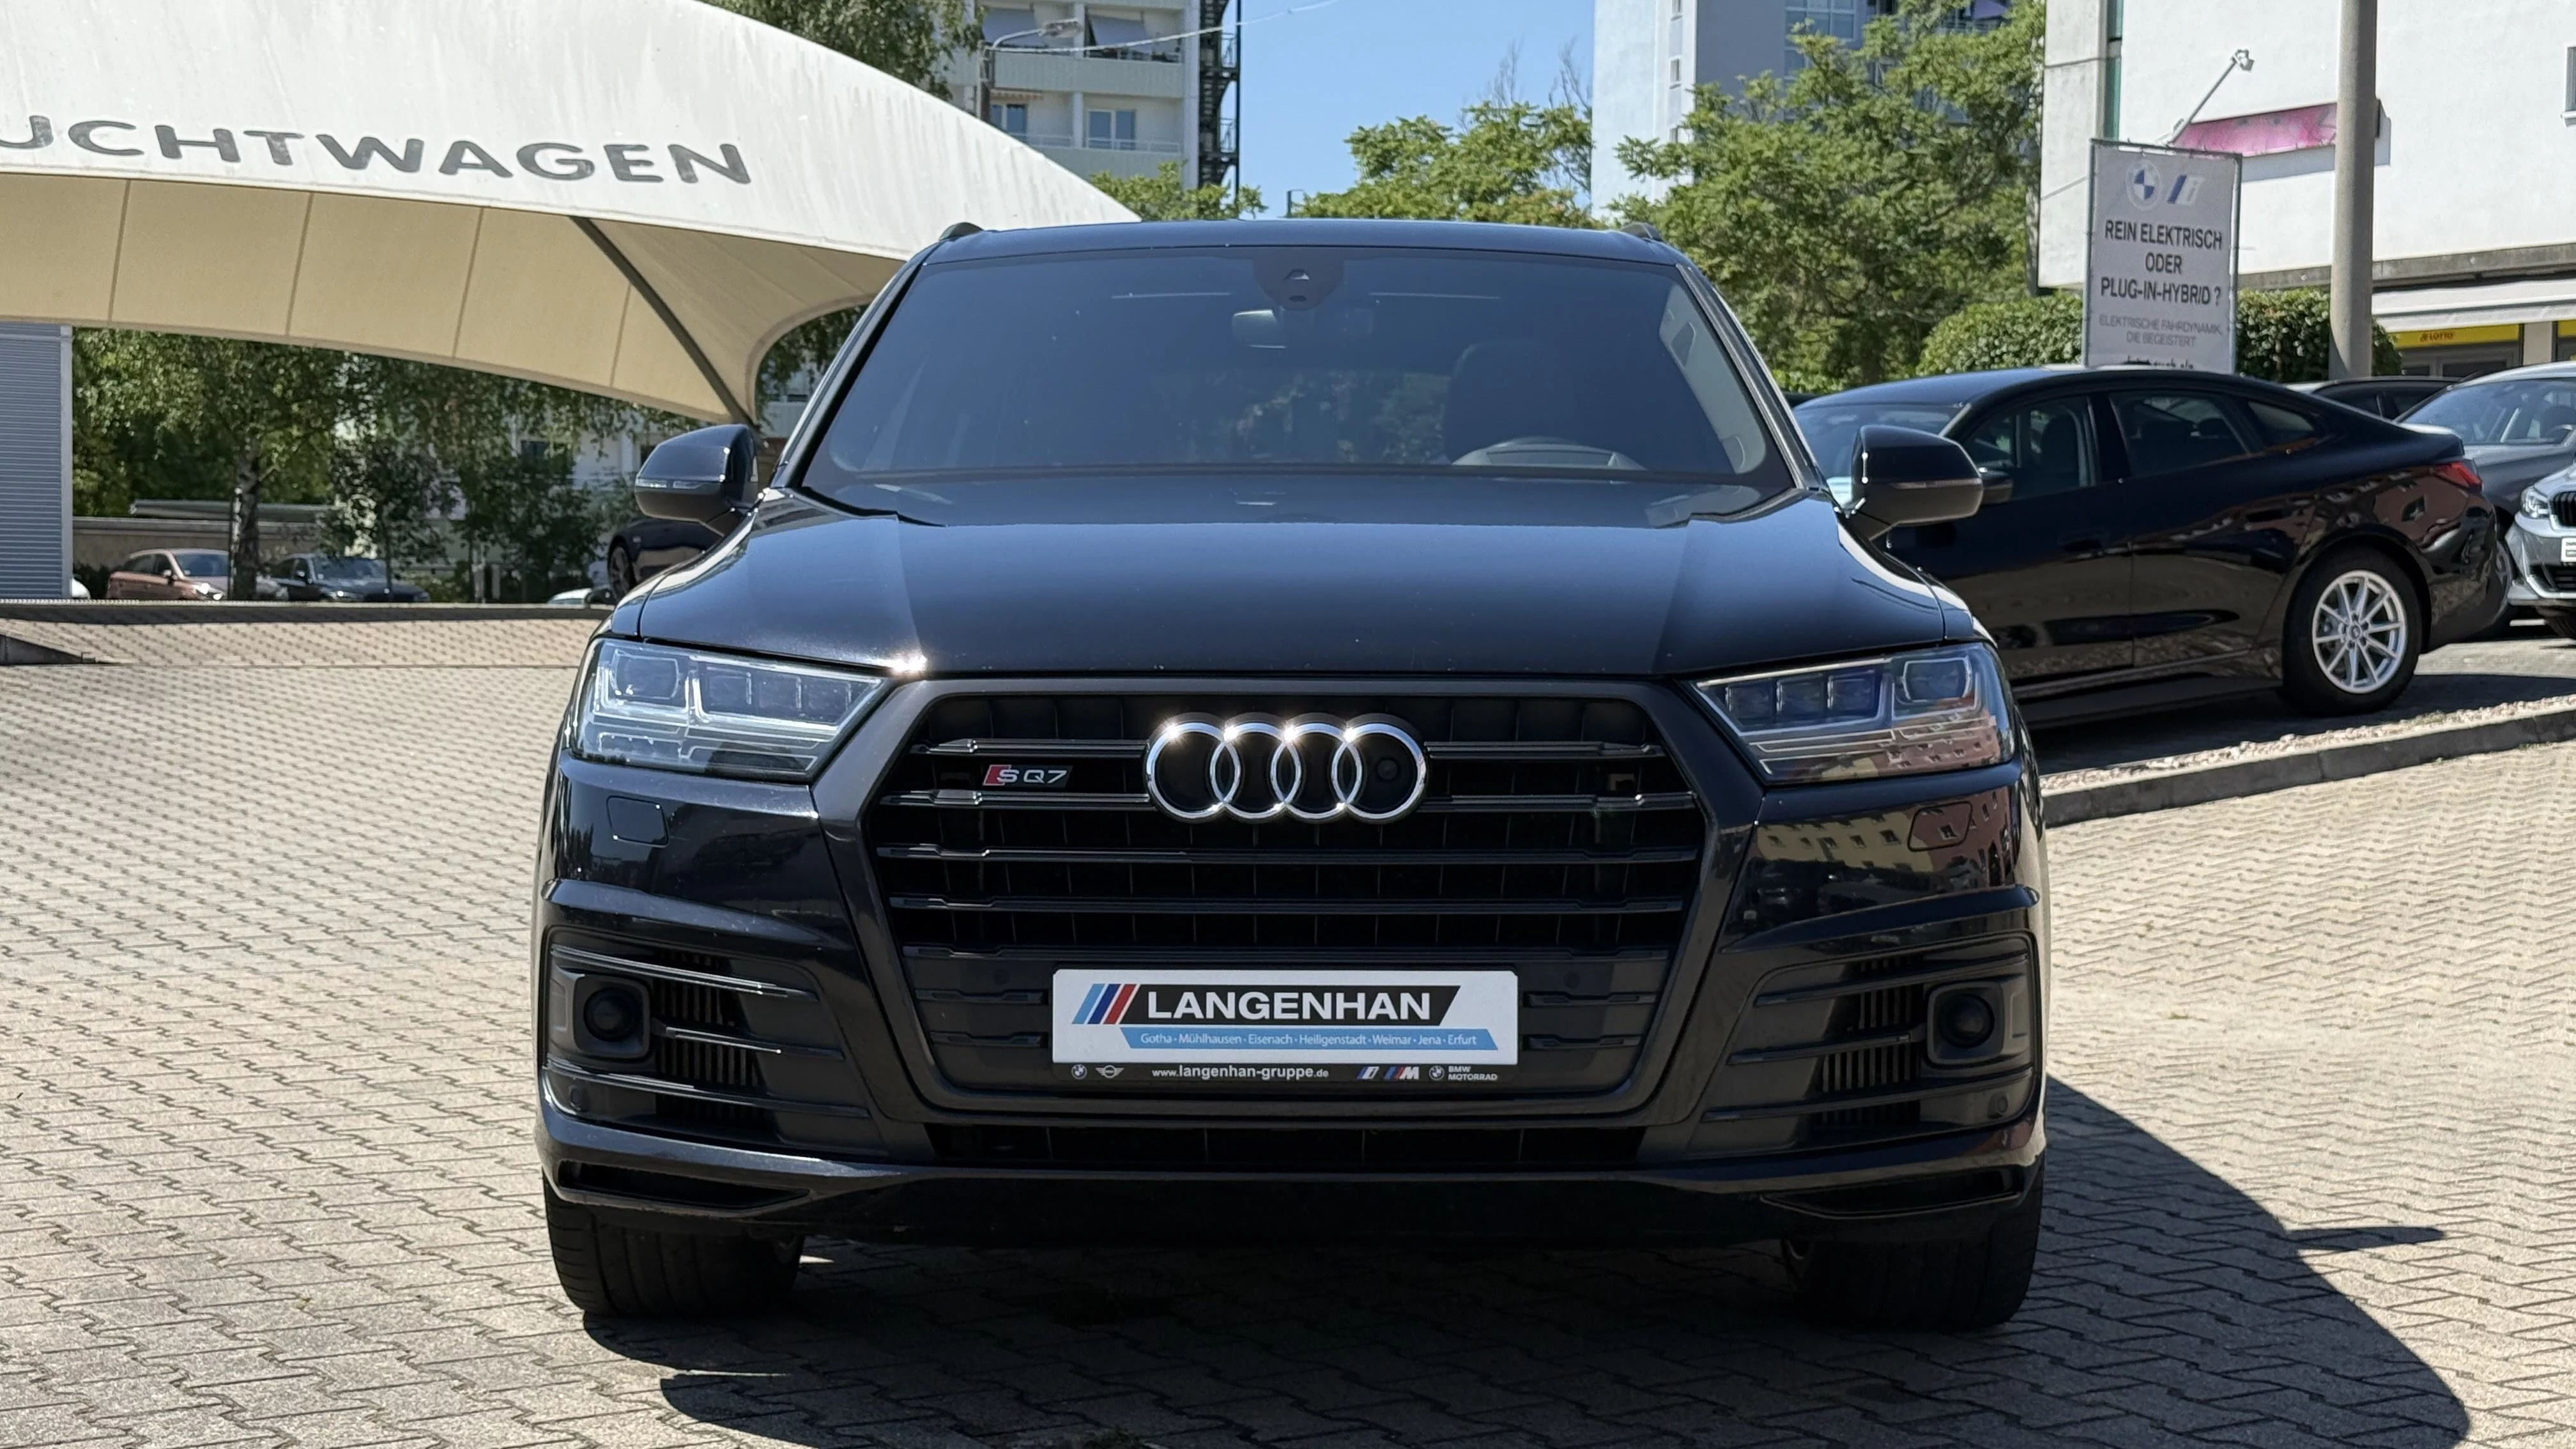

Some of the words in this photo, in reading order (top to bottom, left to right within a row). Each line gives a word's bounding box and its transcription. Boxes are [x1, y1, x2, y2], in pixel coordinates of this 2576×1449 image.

[2104, 220, 2136, 243] REIN
[2140, 223, 2223, 250] ELEKTRISCH
[2145, 252, 2182, 275] ODER
[2101, 277, 2211, 305] PLUG-IN-HYBRID
[2099, 314, 2159, 331] ELEKTRISCHE
[2126, 330, 2140, 343] DIE
[2428, 331, 2454, 341] LOTTO
[1147, 991, 1431, 1021] LANGENHAN
[1140, 1032, 1172, 1044] Gotha
[1178, 1033, 1242, 1045] Mühlhausen
[1248, 1034, 1293, 1045] Eisenach
[1300, 1034, 1367, 1046] Heiligenstadt
[1372, 1034, 1412, 1045] Weimar
[1418, 1034, 1441, 1045] Jena
[1448, 1034, 1477, 1045] Erfurt
[1152, 1064, 1329, 1080] www.langenhan-gruppe.de
